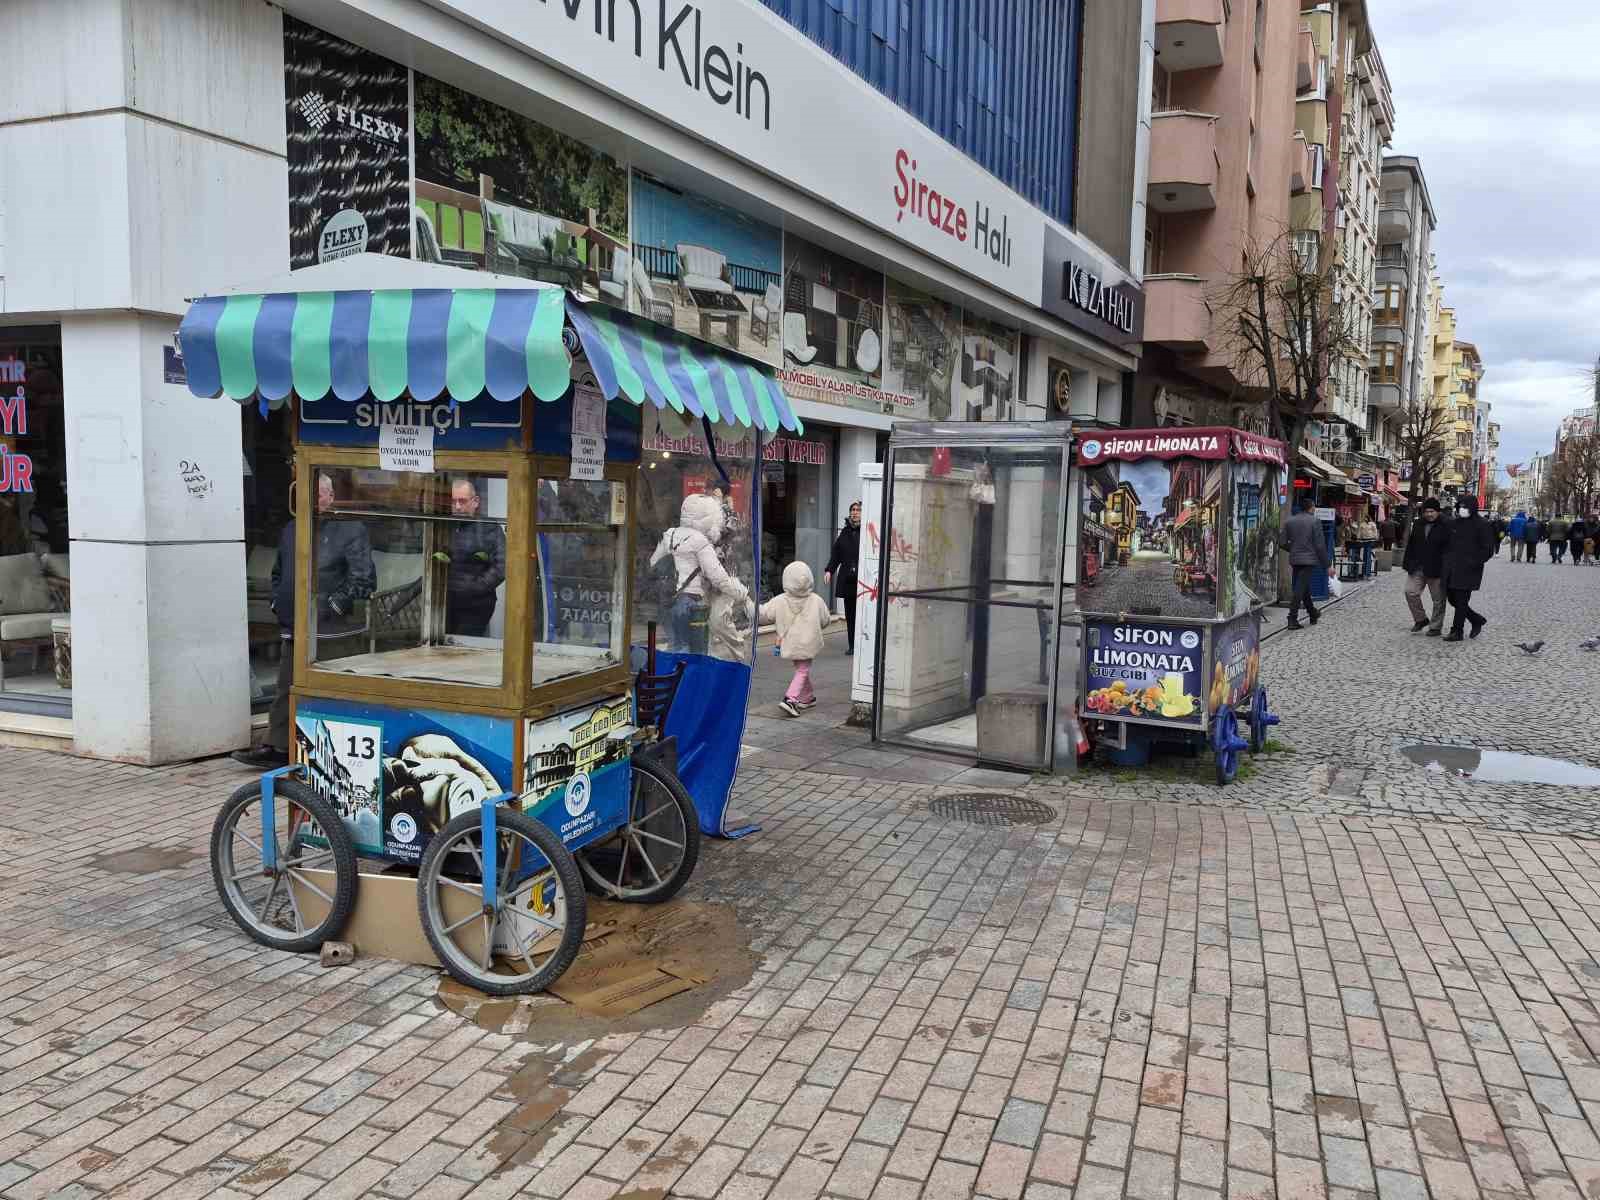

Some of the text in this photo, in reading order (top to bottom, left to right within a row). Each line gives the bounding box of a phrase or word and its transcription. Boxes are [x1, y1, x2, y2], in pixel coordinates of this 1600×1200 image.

[658, 0, 770, 130] Klein
[336, 104, 402, 143] FLEXY
[894, 148, 1012, 268] Şiraze Halı
[323, 224, 365, 250] FLEXY
[1103, 435, 1218, 455] SİFON LİMONATA
[1113, 624, 1173, 646] SİFON
[1094, 646, 1194, 672] LİMONATA
[347, 735, 375, 760] 13
